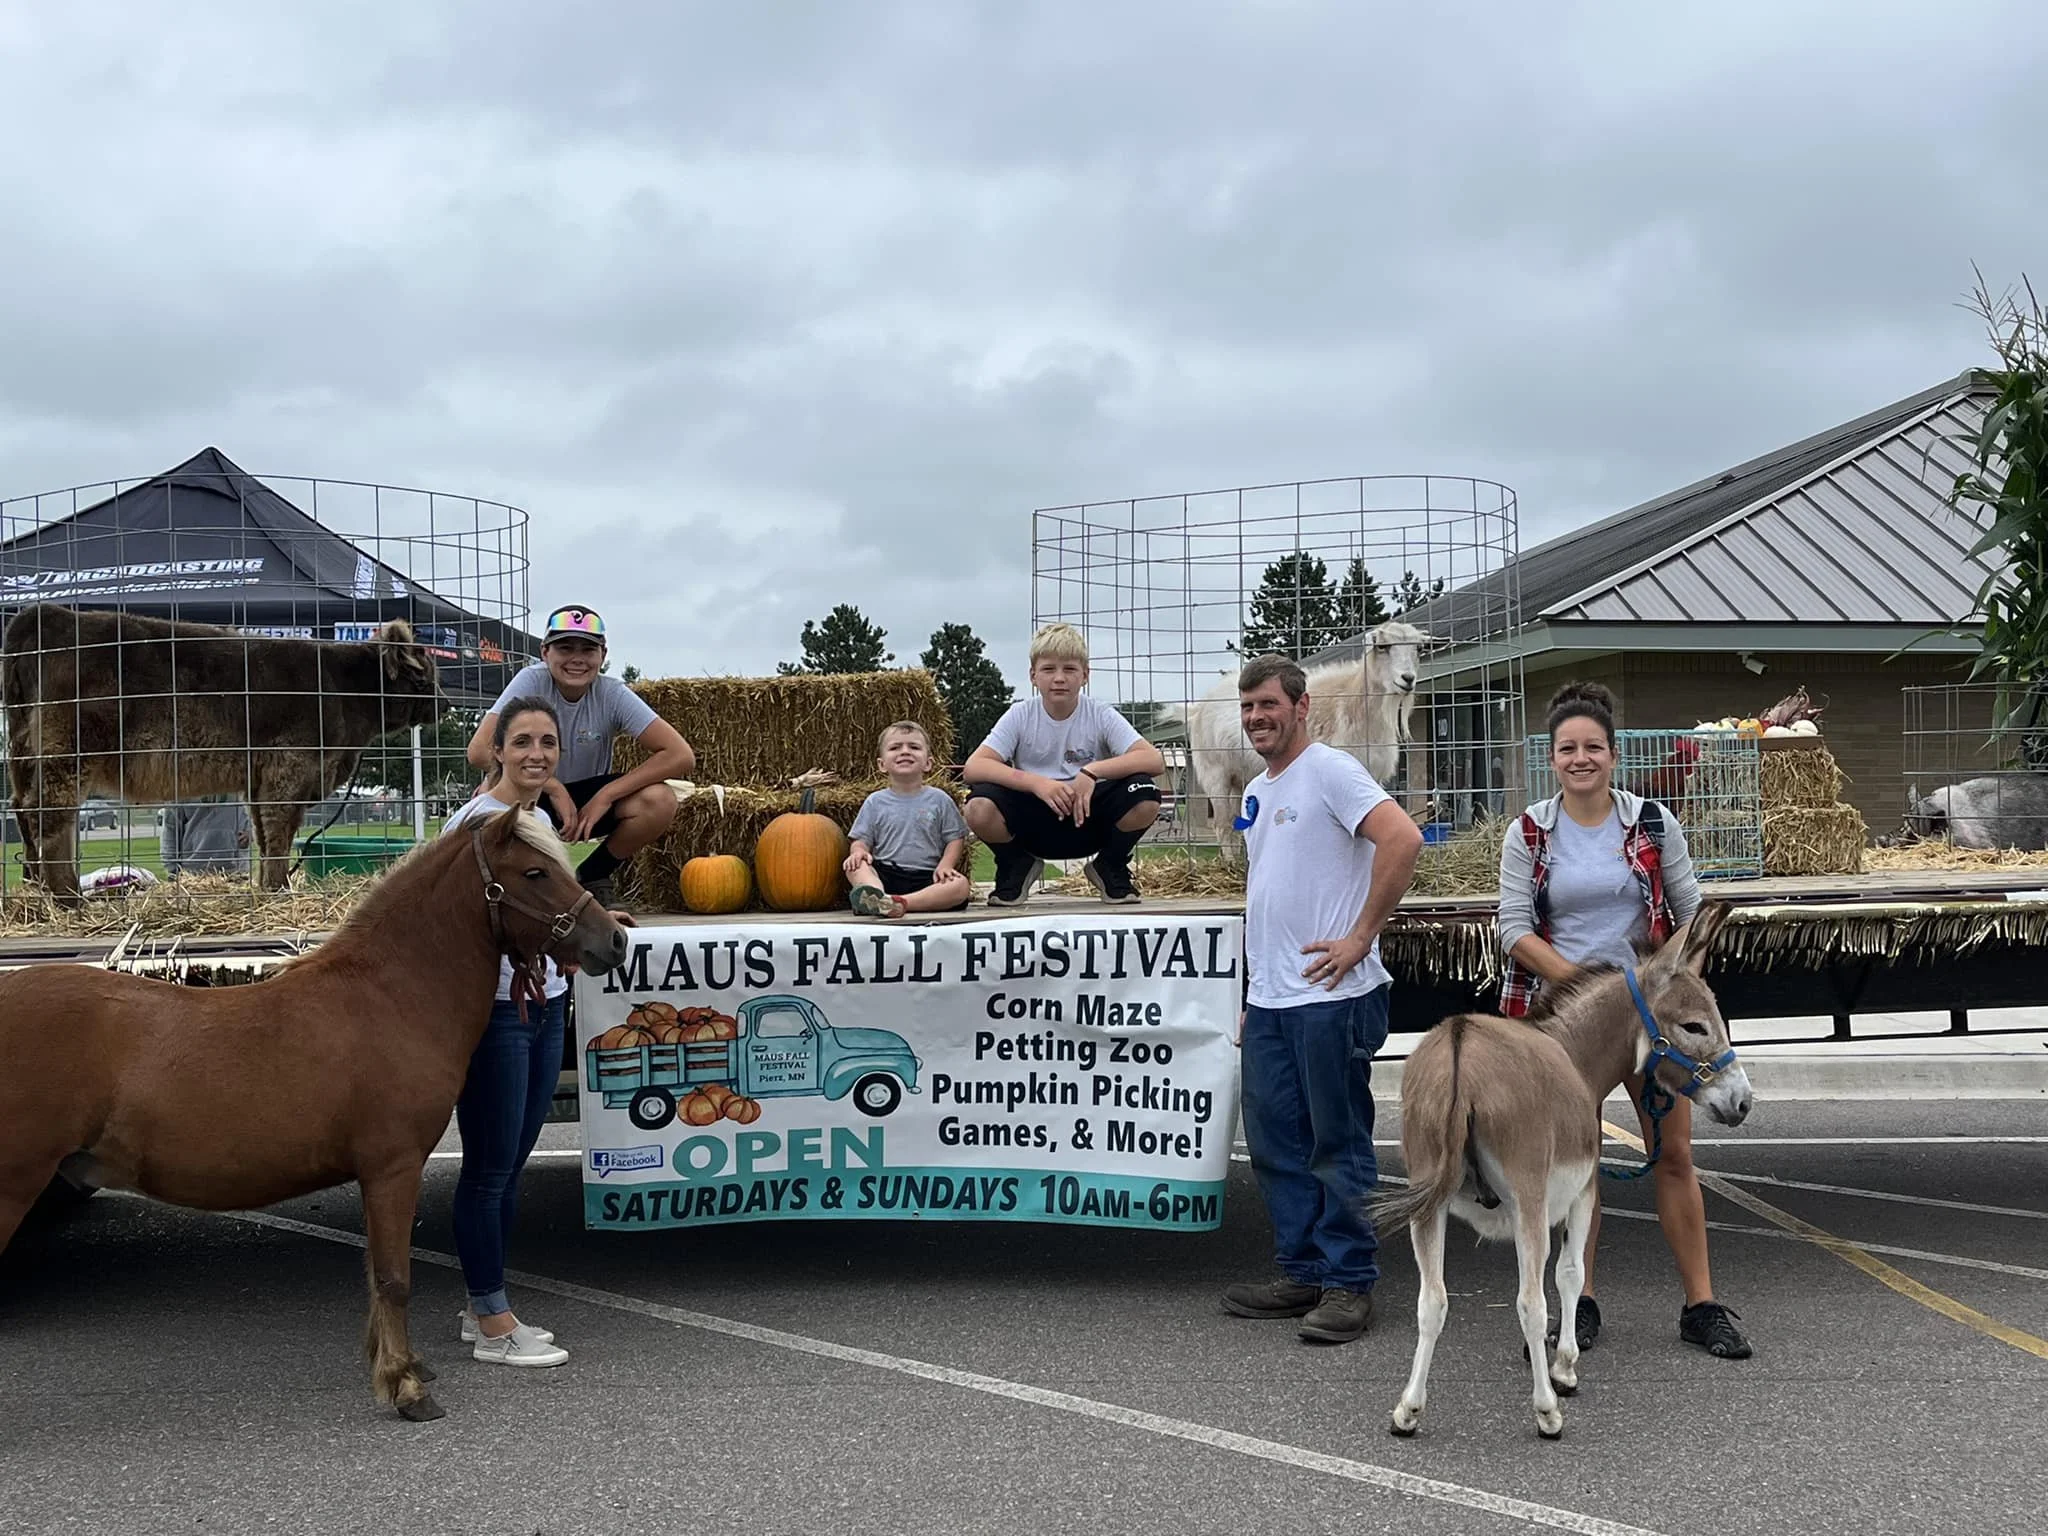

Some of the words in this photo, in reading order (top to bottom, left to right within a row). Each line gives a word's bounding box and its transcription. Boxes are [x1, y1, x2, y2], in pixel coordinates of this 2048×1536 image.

[603, 939, 776, 994] MAUS
[793, 934, 942, 987] FALL
[960, 927, 1236, 982] FESTIVAL
[986, 992, 1063, 1022] Corn
[1076, 994, 1162, 1026] Maze
[754, 1053, 784, 1062] MAUS
[786, 1051, 810, 1060] FALL
[760, 1061, 807, 1071] FESTIVAL
[975, 1030, 1097, 1071] Petting
[1109, 1037, 1173, 1065] Zoo
[788, 1073, 805, 1081] MN
[932, 1072, 1078, 1112] Pumpkin
[1092, 1074, 1213, 1123] Picking
[672, 1126, 885, 1180] OPEN
[938, 1116, 1058, 1153] Games,
[1071, 1118, 1094, 1150] &
[1107, 1120, 1203, 1159] More!
[611, 1155, 657, 1168] Facebook
[602, 1177, 809, 1223] SATURDAYS
[820, 1175, 844, 1209] &
[857, 1174, 1019, 1211] SUNDAYS
[1040, 1174, 1218, 1223] 10AM-6PM
